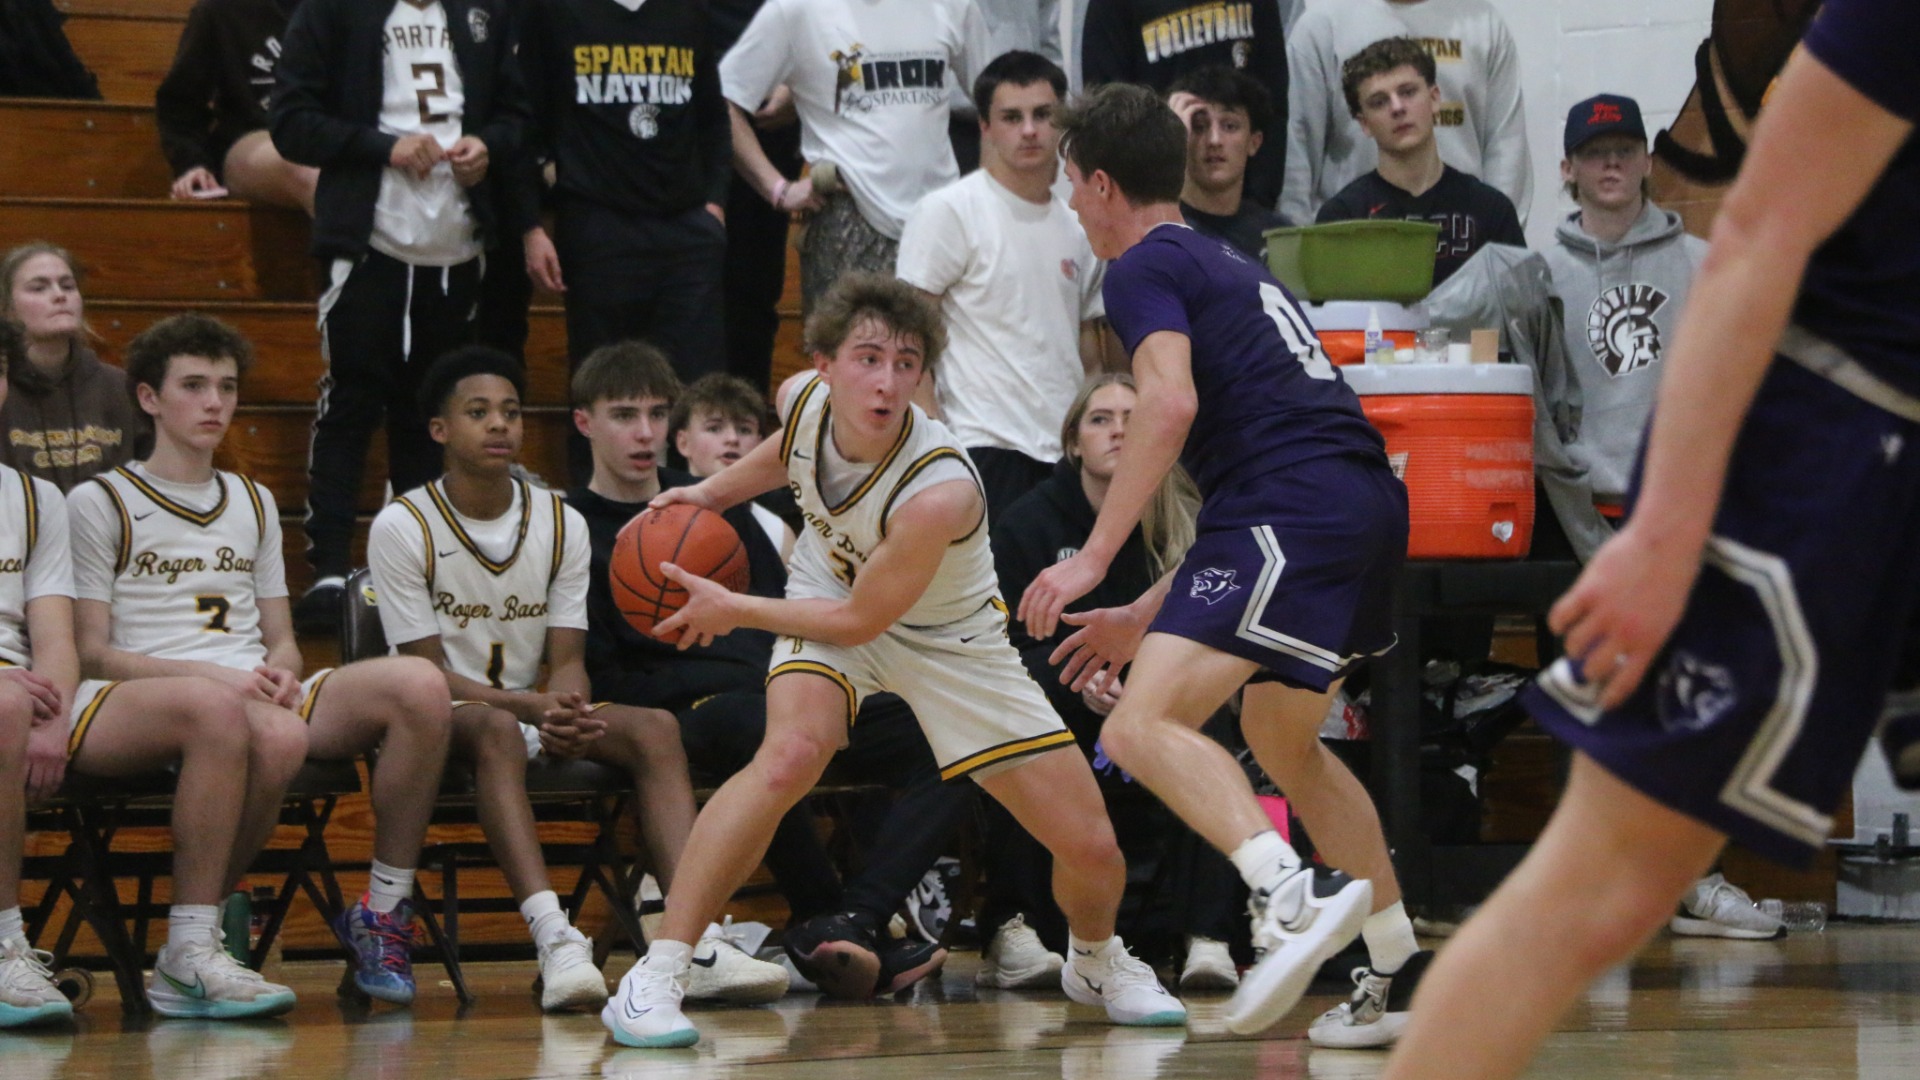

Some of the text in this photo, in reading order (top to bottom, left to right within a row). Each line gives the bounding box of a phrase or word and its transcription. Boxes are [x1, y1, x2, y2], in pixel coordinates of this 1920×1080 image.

[1142, 2, 1254, 63] VOLLEYBALL
[574, 45, 695, 77] SPARTAN
[862, 58, 945, 91] IRON
[411, 63, 448, 124] 2
[575, 74, 693, 104] NATION
[132, 551, 206, 584] Roger
[434, 592, 492, 628] Roger
